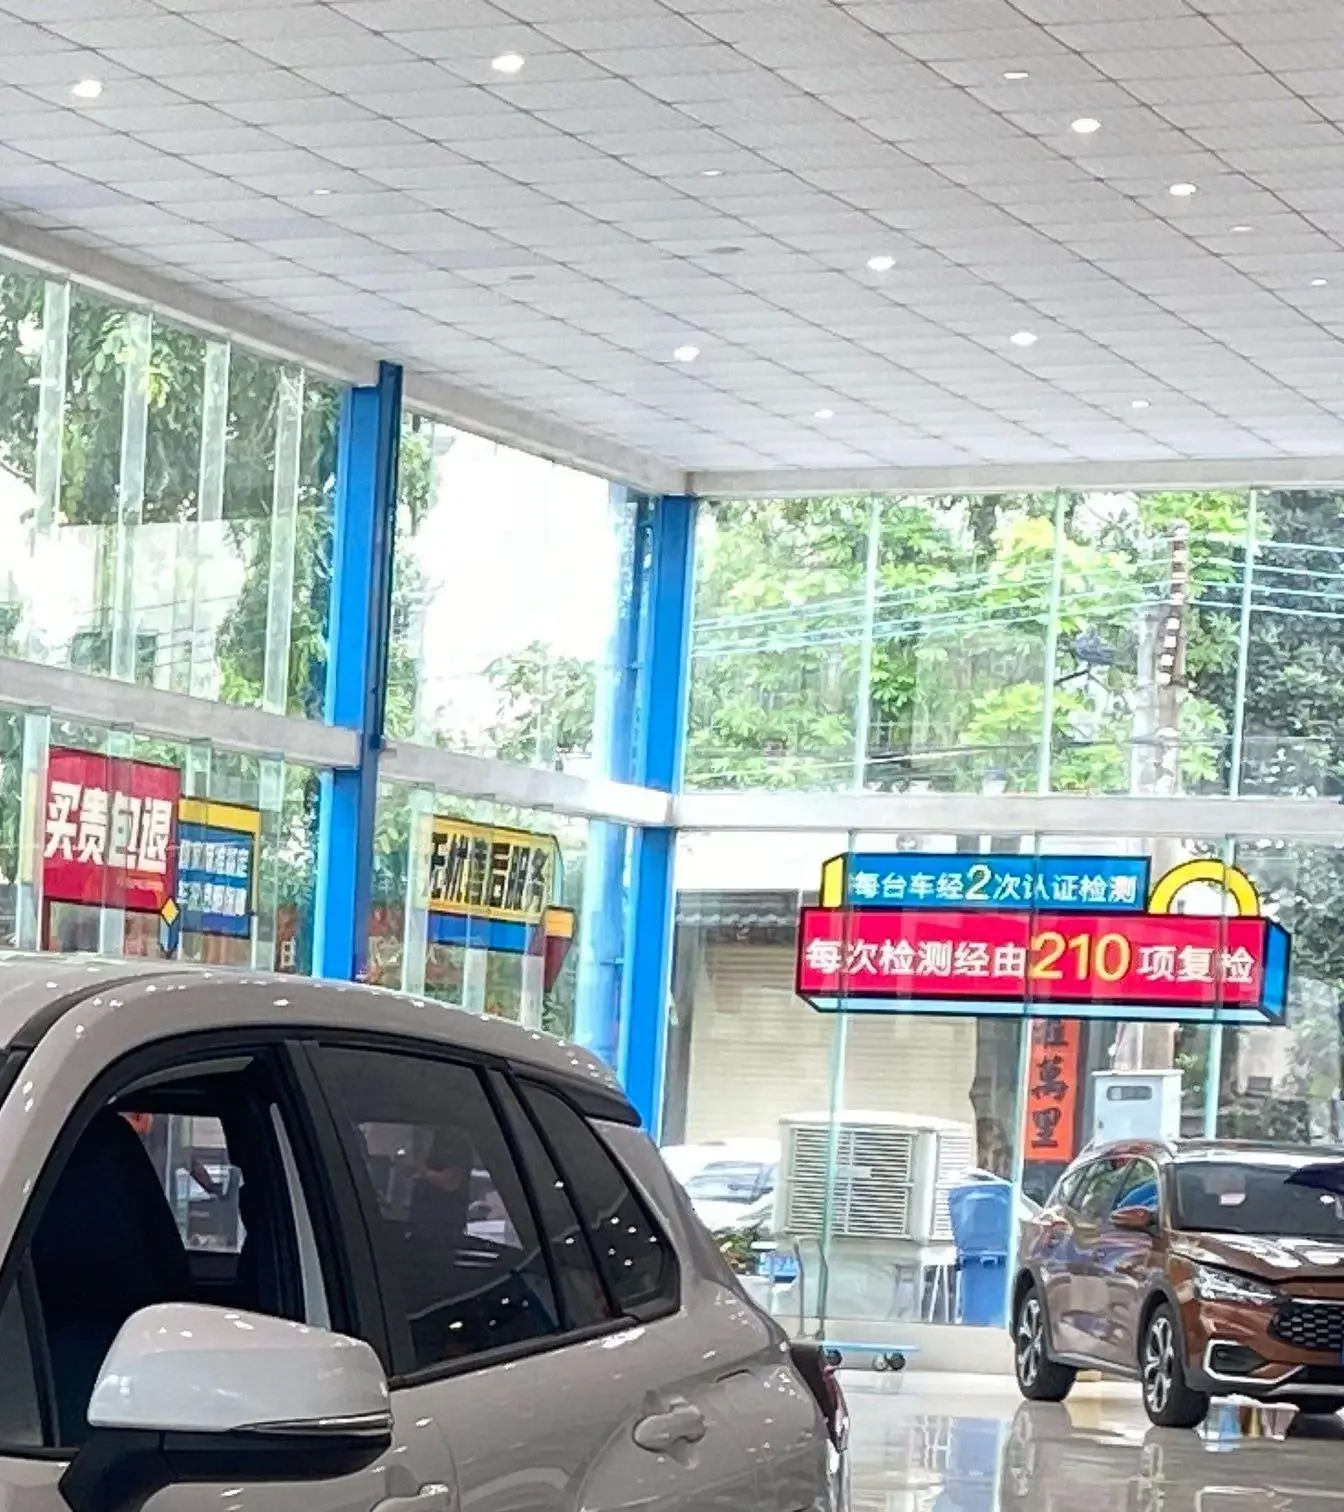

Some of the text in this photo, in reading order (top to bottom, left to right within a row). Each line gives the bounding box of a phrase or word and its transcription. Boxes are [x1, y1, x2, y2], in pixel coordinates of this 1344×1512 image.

[43, 780, 172, 874] 买贵包退
[852, 864, 1136, 903] 每台车经2次认证检测
